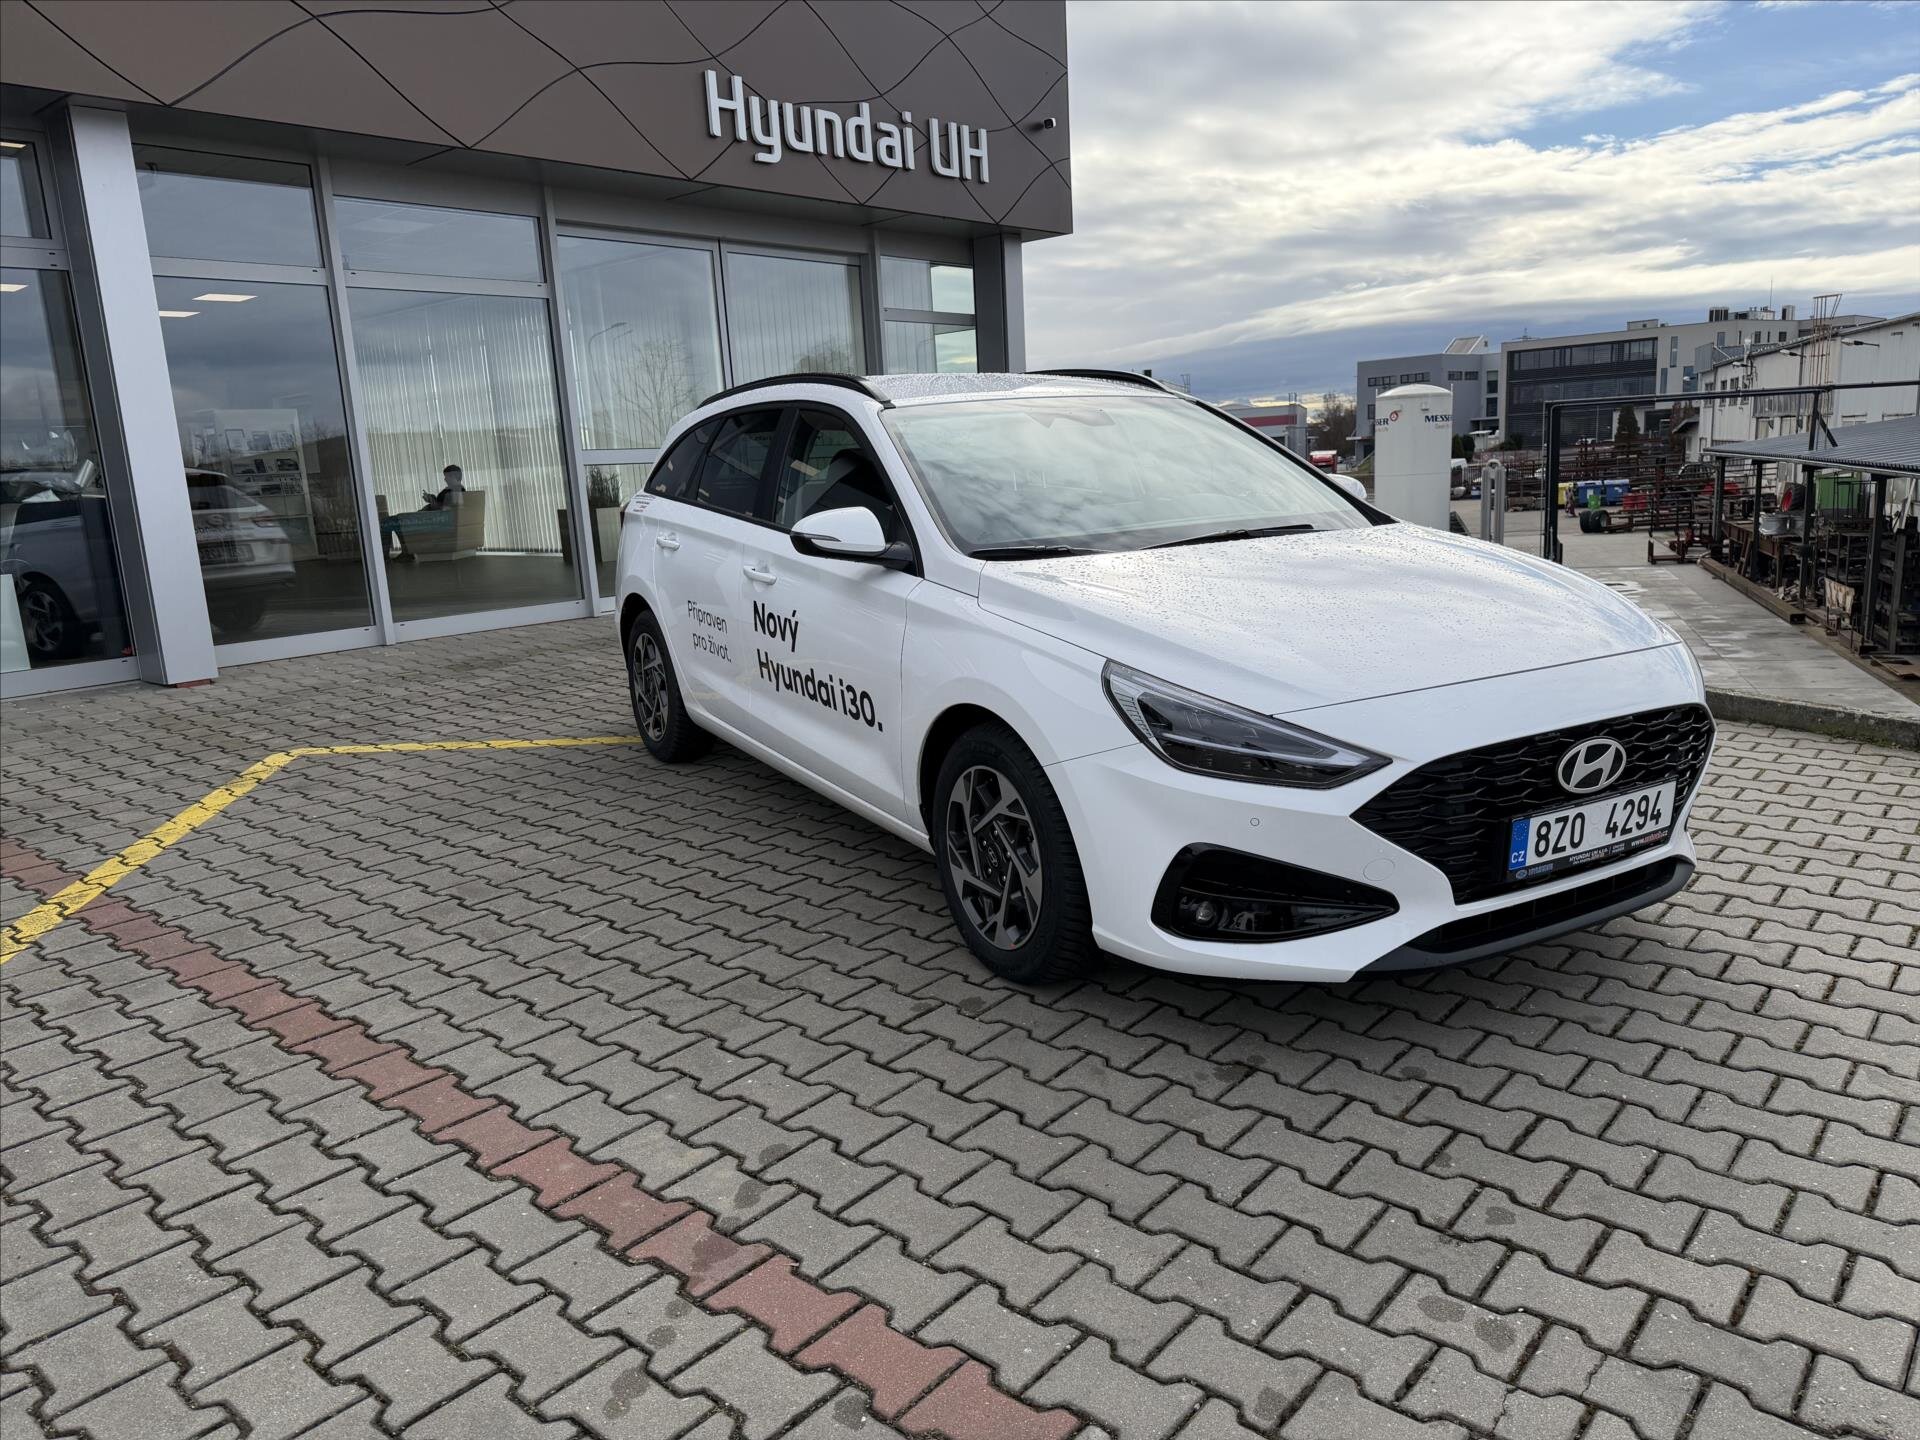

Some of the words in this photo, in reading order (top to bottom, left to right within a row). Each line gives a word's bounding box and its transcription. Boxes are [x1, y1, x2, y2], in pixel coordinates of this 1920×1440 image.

[704, 69, 915, 170] Hyundai
[929, 117, 990, 184] UH
[687, 600, 728, 635] Připraven
[753, 600, 799, 653] Nový
[692, 632, 708, 651] pro
[708, 635, 732, 663] život.
[756, 648, 838, 712] Hyundai
[838, 678, 884, 733] i30.
[1605, 790, 1662, 839] 4294
[1511, 850, 1526, 864] CZ
